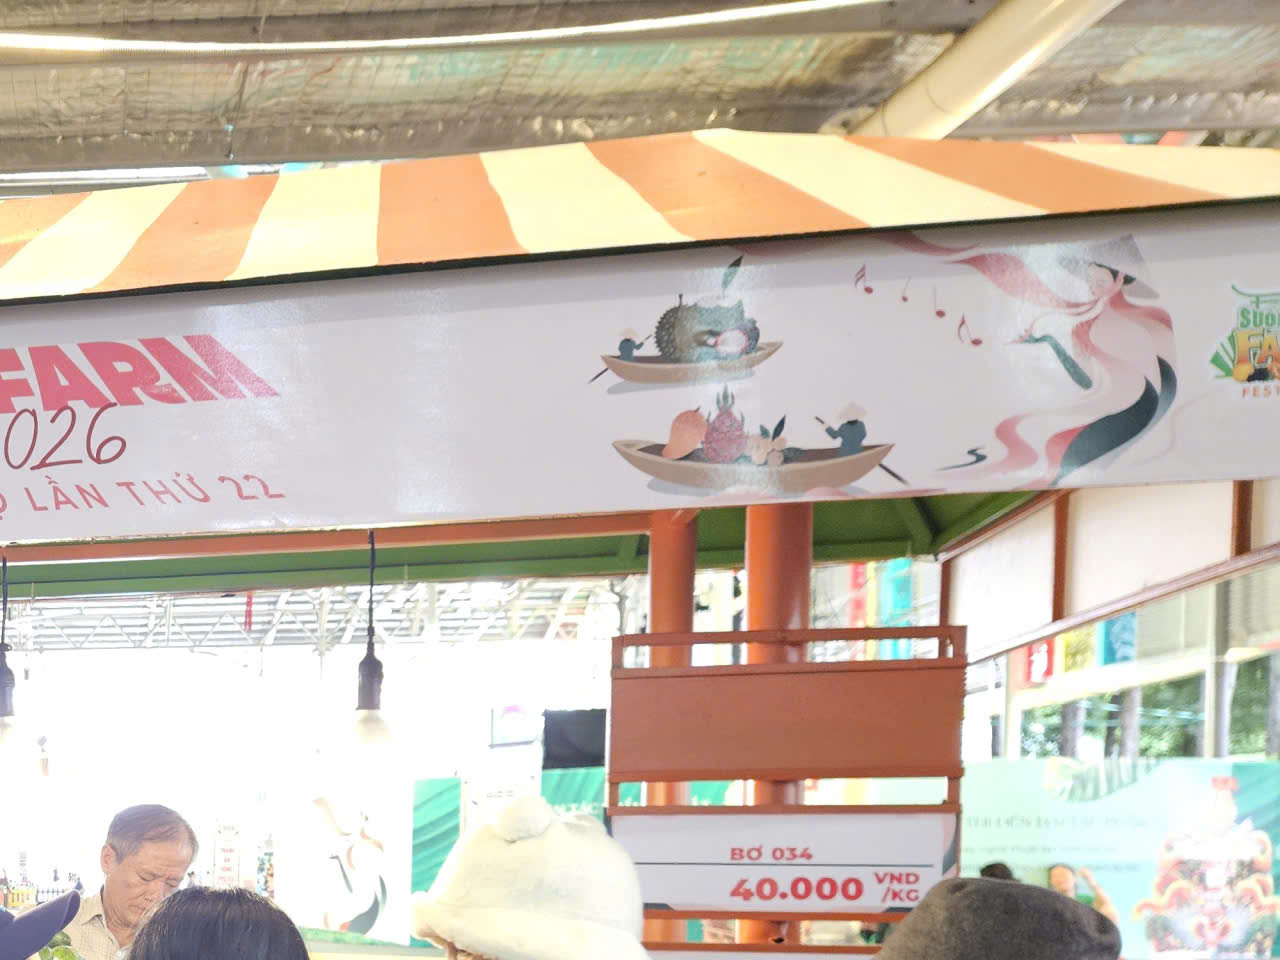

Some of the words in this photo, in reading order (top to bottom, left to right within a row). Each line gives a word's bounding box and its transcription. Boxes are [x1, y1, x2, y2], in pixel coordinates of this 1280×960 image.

[24, 475, 110, 511] LẦN
[116, 472, 211, 506] THỨ
[218, 474, 286, 499] 22
[730, 846, 763, 861] BƠ
[772, 847, 813, 861] 034
[874, 872, 920, 885] VND
[730, 877, 864, 901] 40.000
[881, 888, 920, 902] /KG
